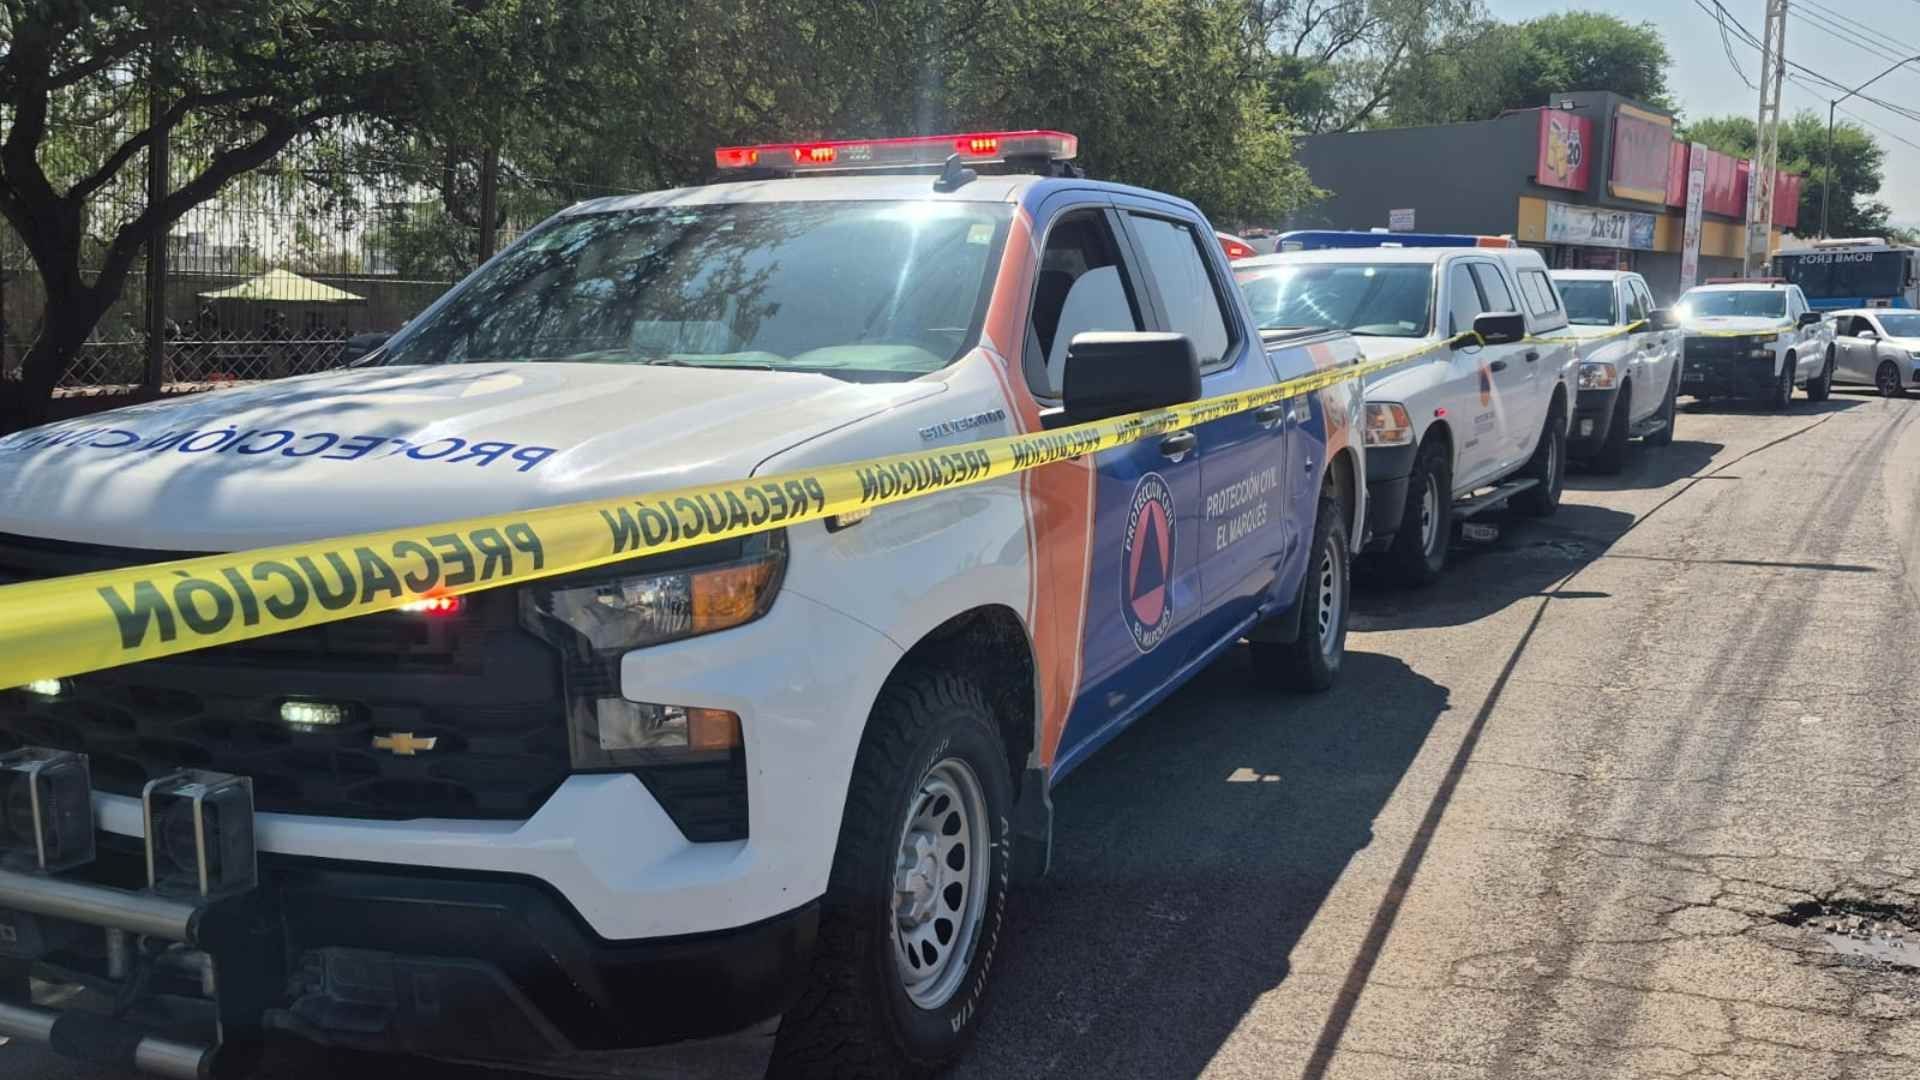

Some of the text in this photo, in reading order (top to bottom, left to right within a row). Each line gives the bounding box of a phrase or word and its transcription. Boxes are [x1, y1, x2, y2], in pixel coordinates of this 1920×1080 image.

[1206, 473, 1259, 521] PROTECCIÓN
[1216, 499, 1266, 551] EL MARQUÉS
